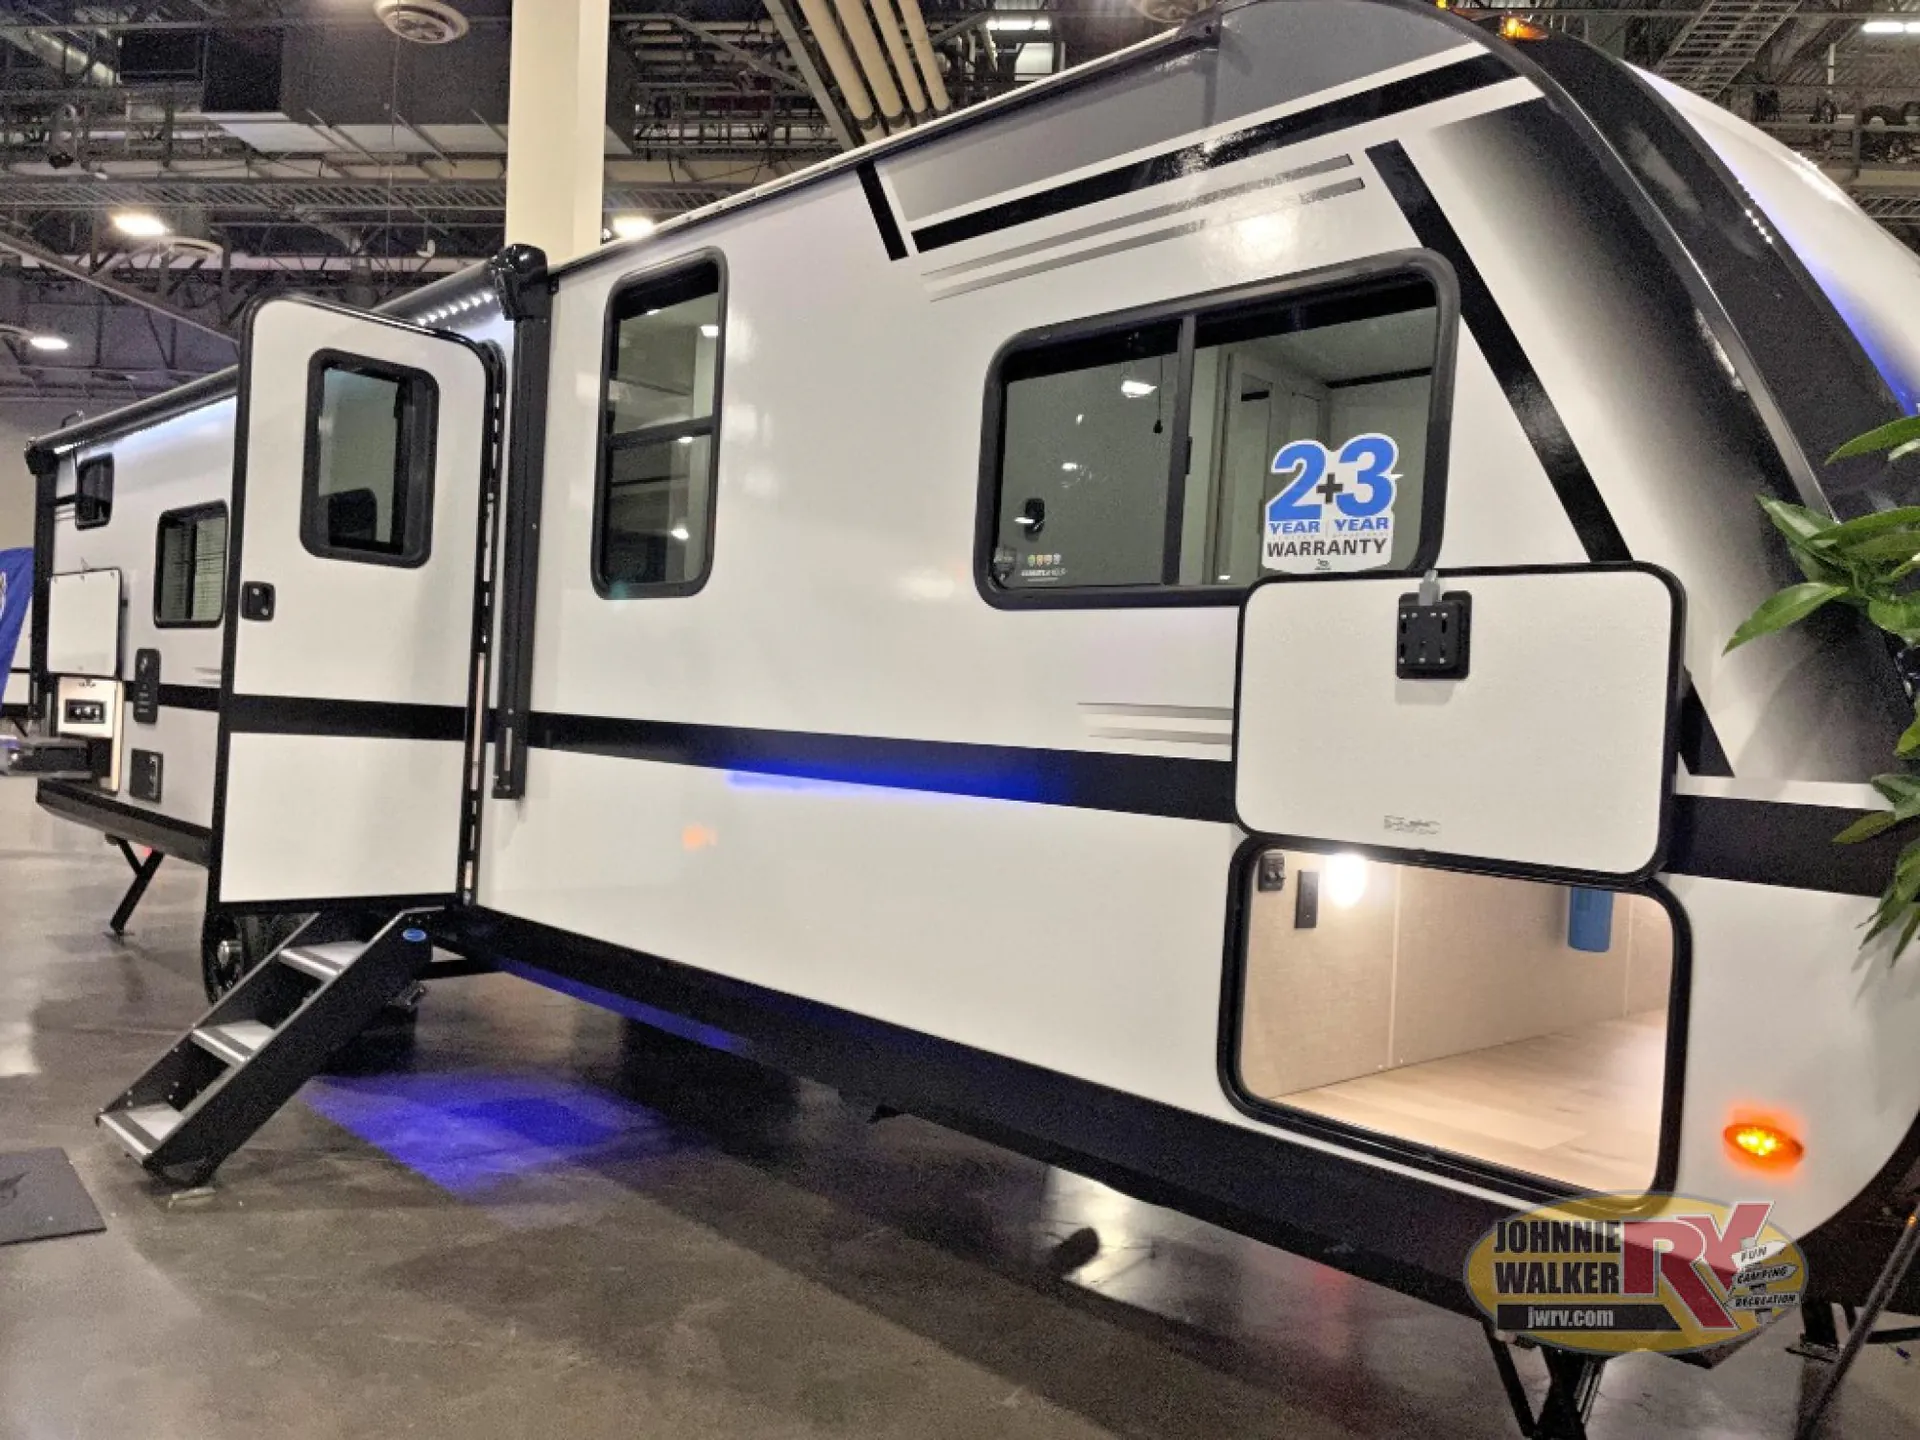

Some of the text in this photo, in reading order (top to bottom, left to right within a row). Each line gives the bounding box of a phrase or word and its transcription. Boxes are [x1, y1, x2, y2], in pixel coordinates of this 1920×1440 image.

[1269, 521, 1321, 535] YEAR
[1334, 517, 1390, 531] YEAR
[1267, 539, 1388, 557] WARRANTY
